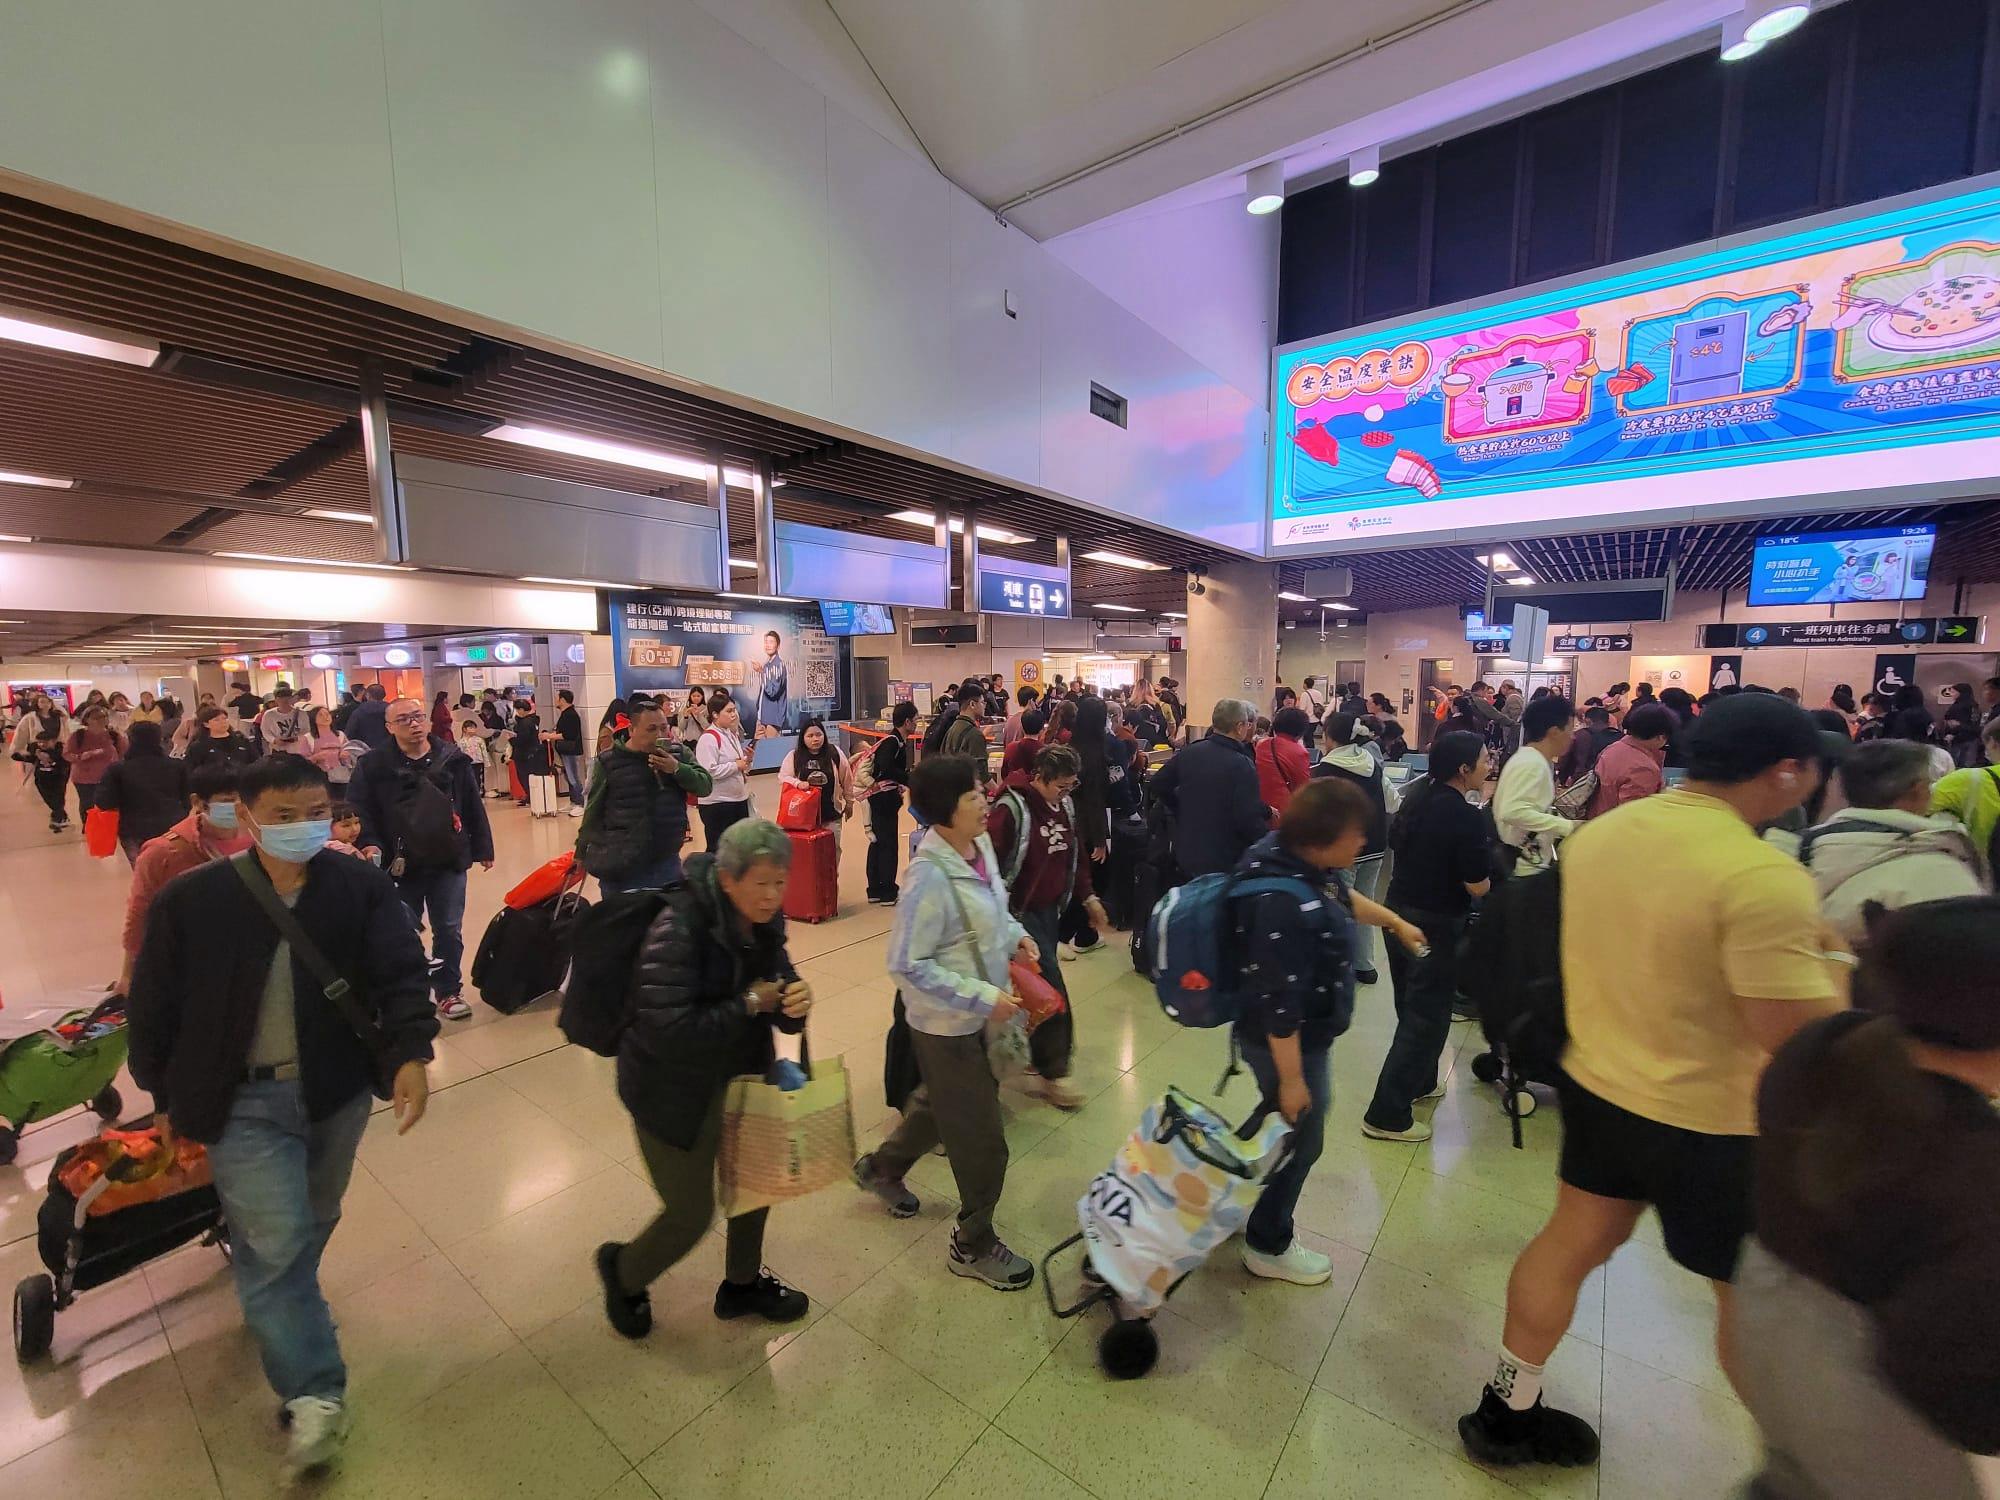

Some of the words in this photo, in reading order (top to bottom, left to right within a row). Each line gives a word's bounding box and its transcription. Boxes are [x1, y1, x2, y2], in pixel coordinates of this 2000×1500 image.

[1901, 526, 1928, 535] 19:26
[1780, 536, 1799, 544] 18°C
[1778, 623, 1891, 637] 下一班列車往金鐘
[1837, 636, 1872, 644] Admiralty
